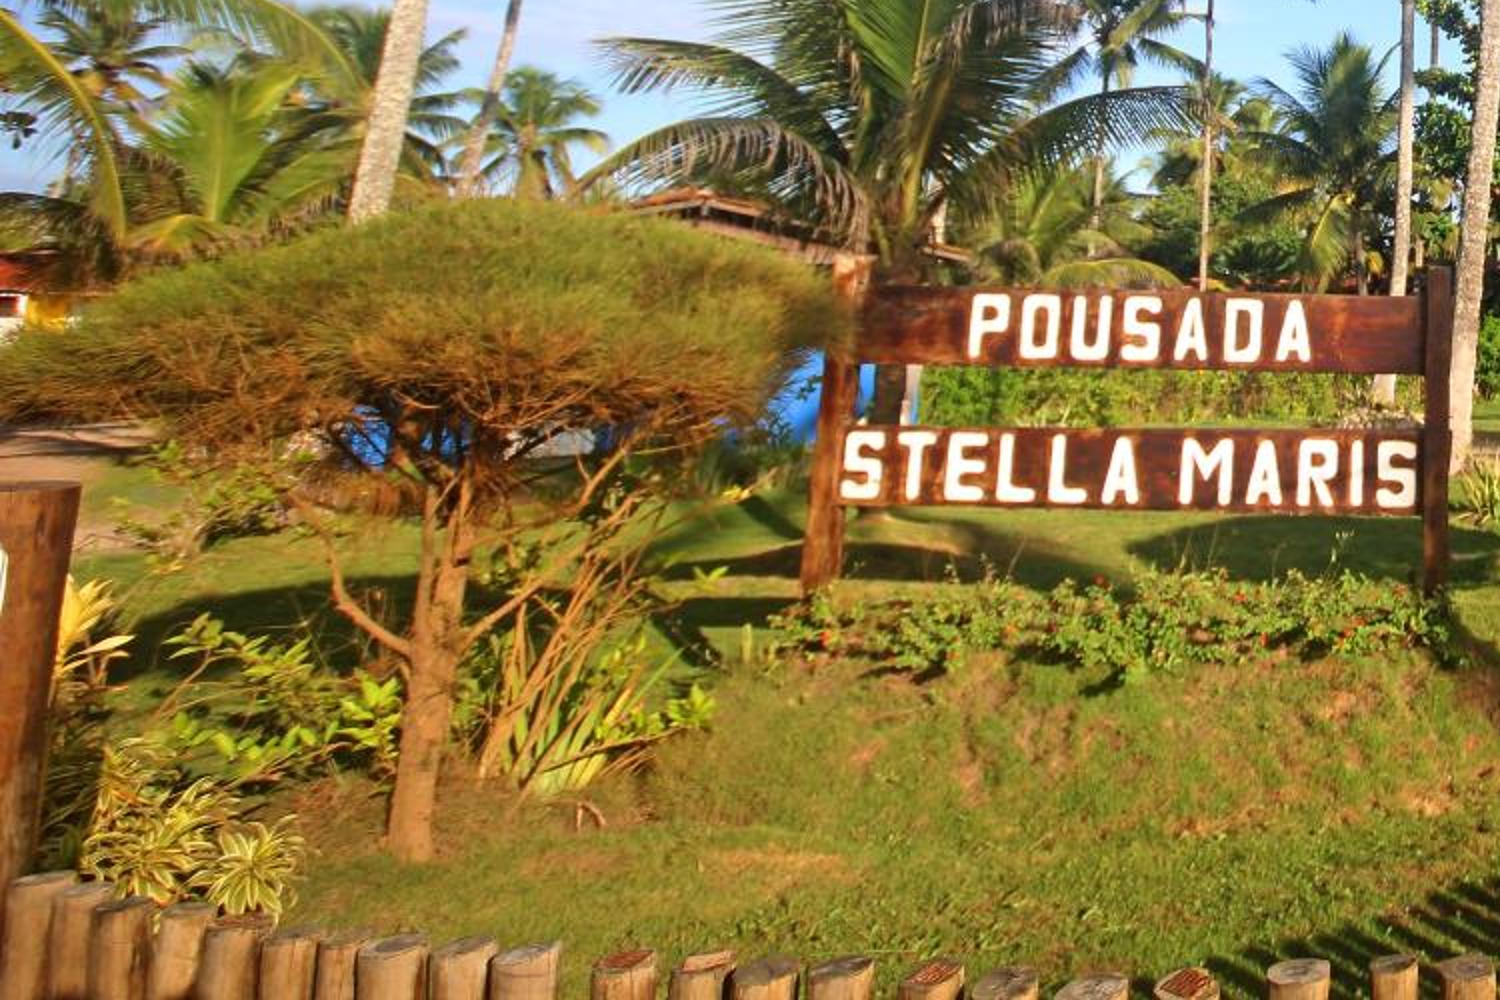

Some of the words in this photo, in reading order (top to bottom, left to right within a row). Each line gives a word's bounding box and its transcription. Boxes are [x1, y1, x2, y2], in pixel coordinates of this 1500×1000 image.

[969, 293, 1311, 363] POUSADA
[840, 431, 1139, 505] STELLA
[1178, 437, 1417, 508] MARIS
